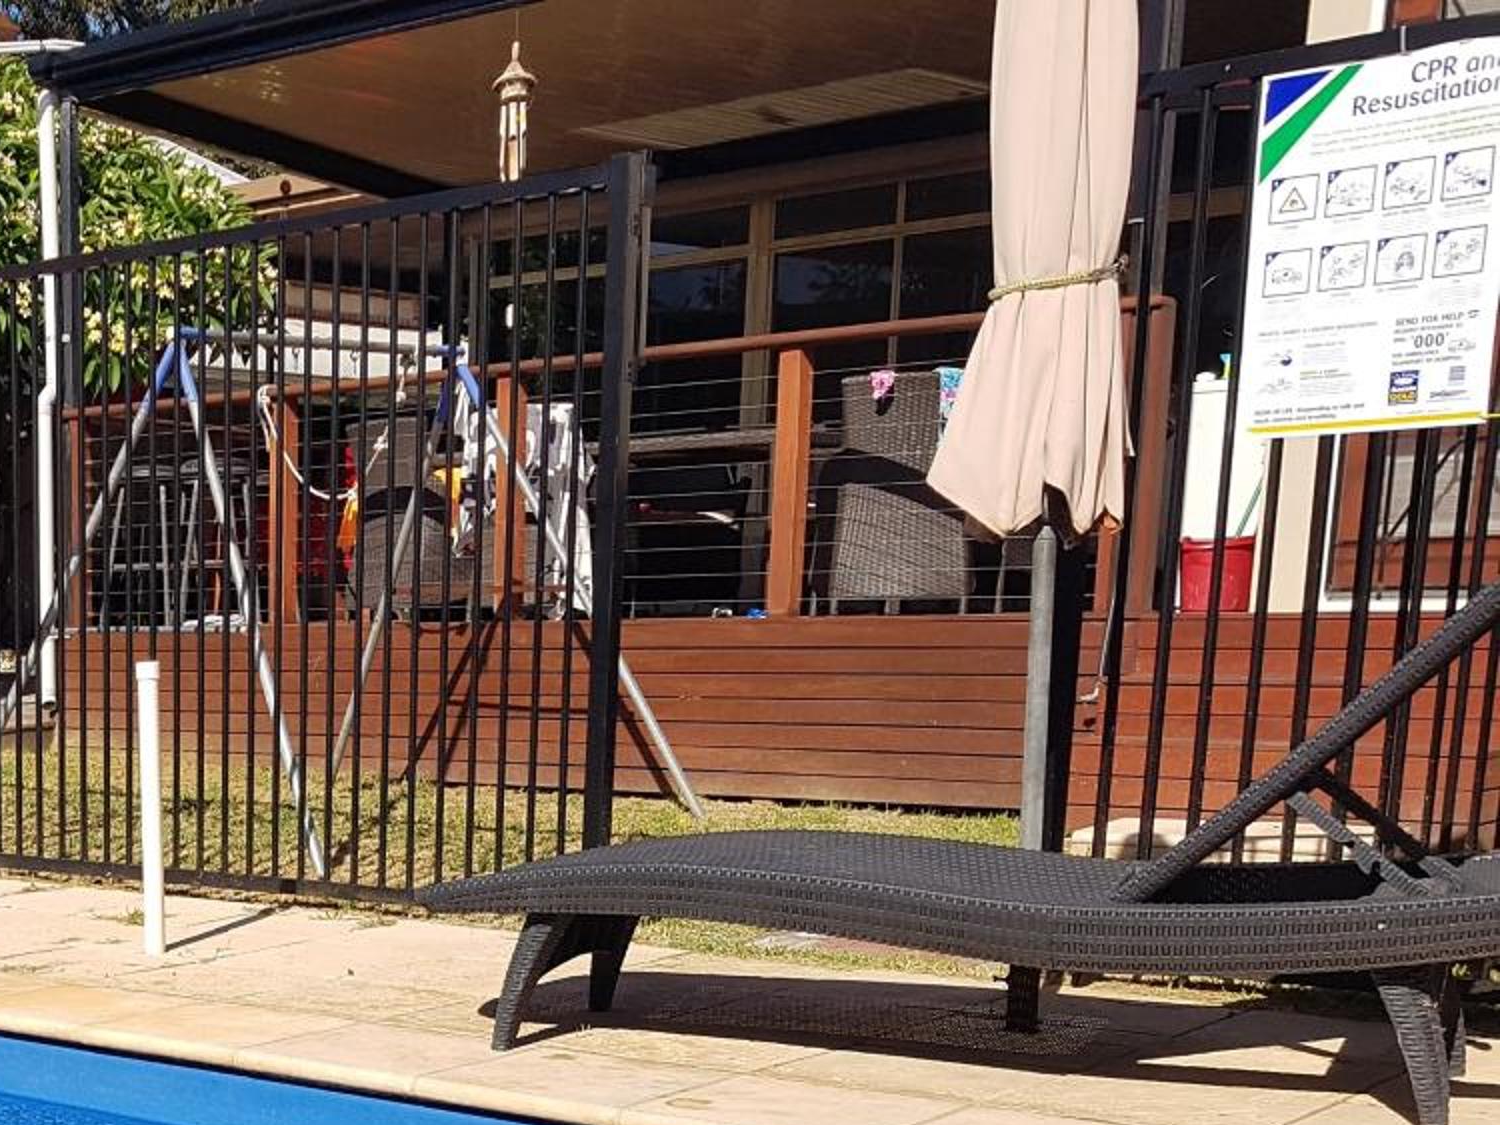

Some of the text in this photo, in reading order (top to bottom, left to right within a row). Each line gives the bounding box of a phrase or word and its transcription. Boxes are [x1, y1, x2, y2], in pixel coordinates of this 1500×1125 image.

[1410, 53, 1500, 83] CPR an
[1421, 313, 1438, 324] FOR
[1441, 311, 1465, 321] HELP
